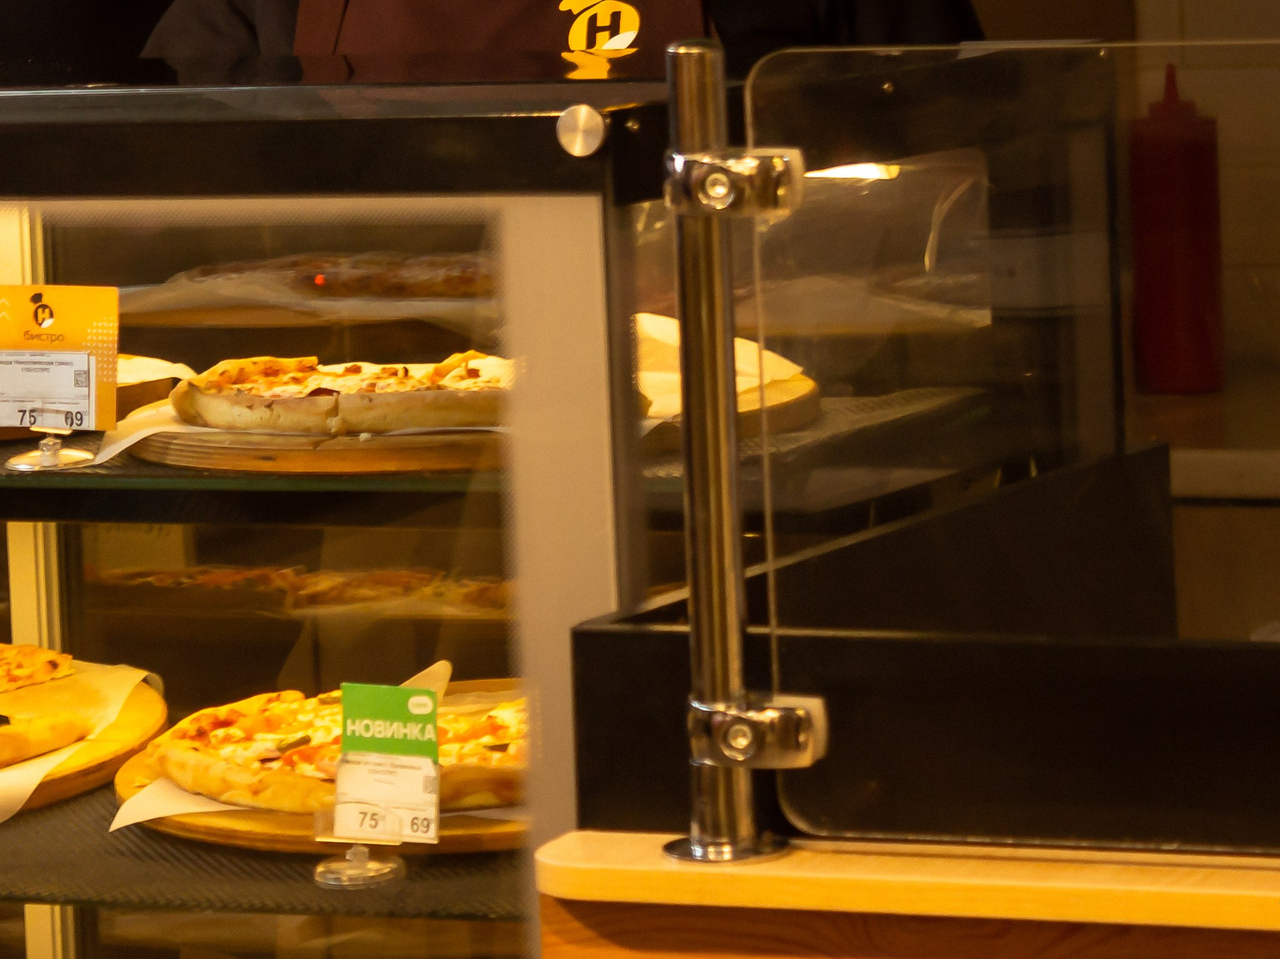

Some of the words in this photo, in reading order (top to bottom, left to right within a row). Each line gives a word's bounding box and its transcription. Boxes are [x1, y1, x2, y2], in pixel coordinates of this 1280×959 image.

[23, 330, 65, 344] бистро
[17, 409, 37, 426] 75
[346, 719, 437, 742] НОВИНКА
[359, 811, 380, 829] 75
[410, 816, 431, 834] 69
